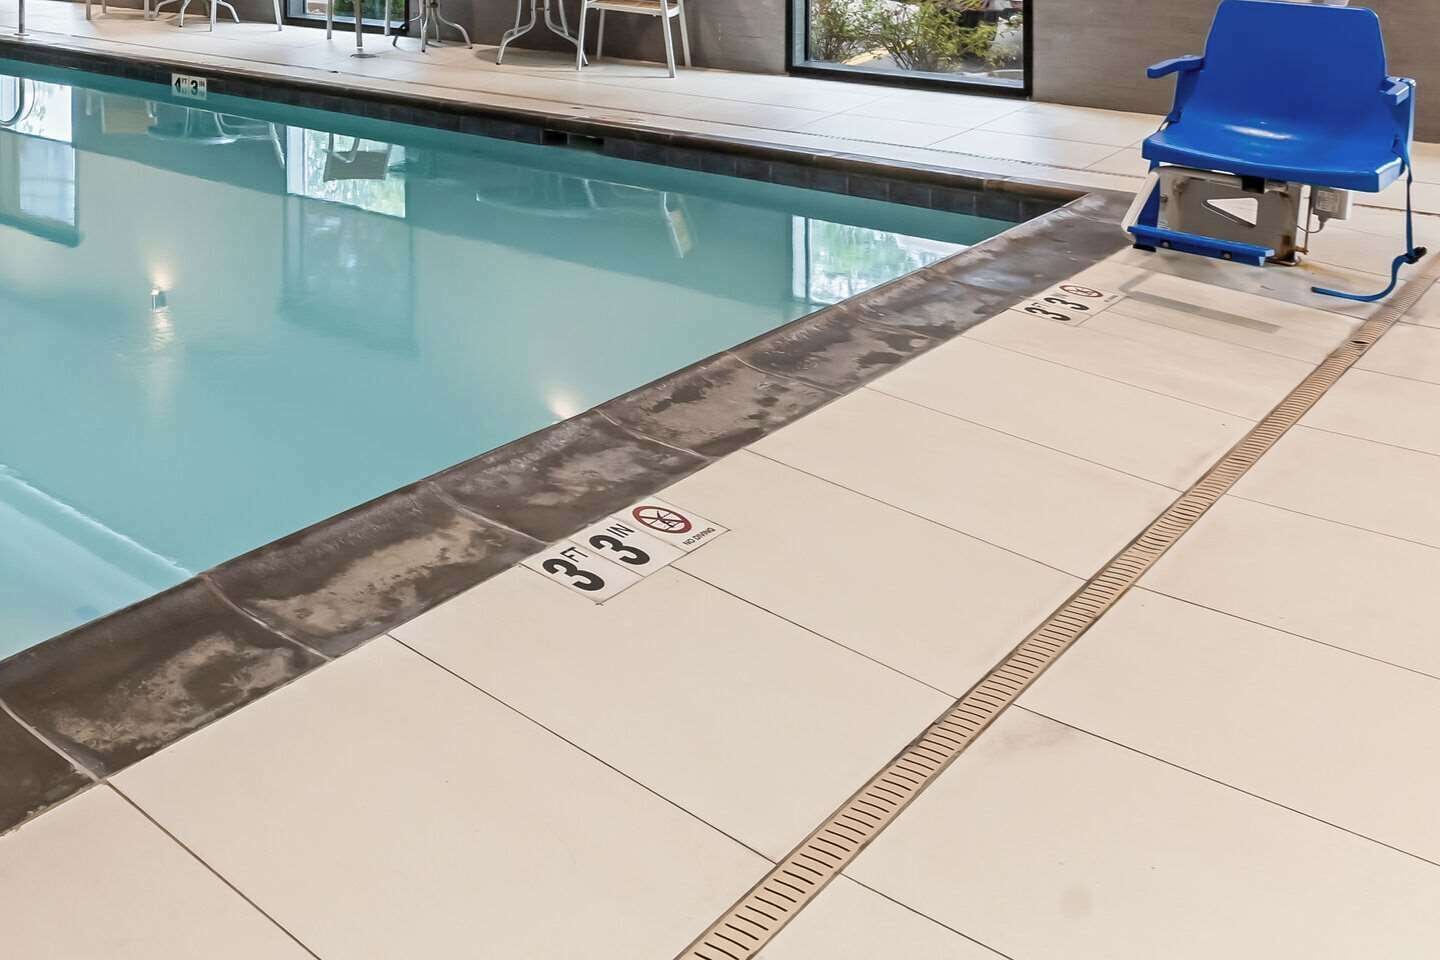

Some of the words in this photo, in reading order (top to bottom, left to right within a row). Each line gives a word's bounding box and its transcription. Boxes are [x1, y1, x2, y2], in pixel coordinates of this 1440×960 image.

[1043, 297, 1090, 311] 3
[1024, 307, 1071, 321] 3
[607, 523, 636, 539] IN
[683, 538, 695, 546] NO
[694, 527, 716, 541] DIVING
[560, 546, 590, 563] FT
[588, 534, 651, 566] 3
[542, 558, 605, 592] 3
